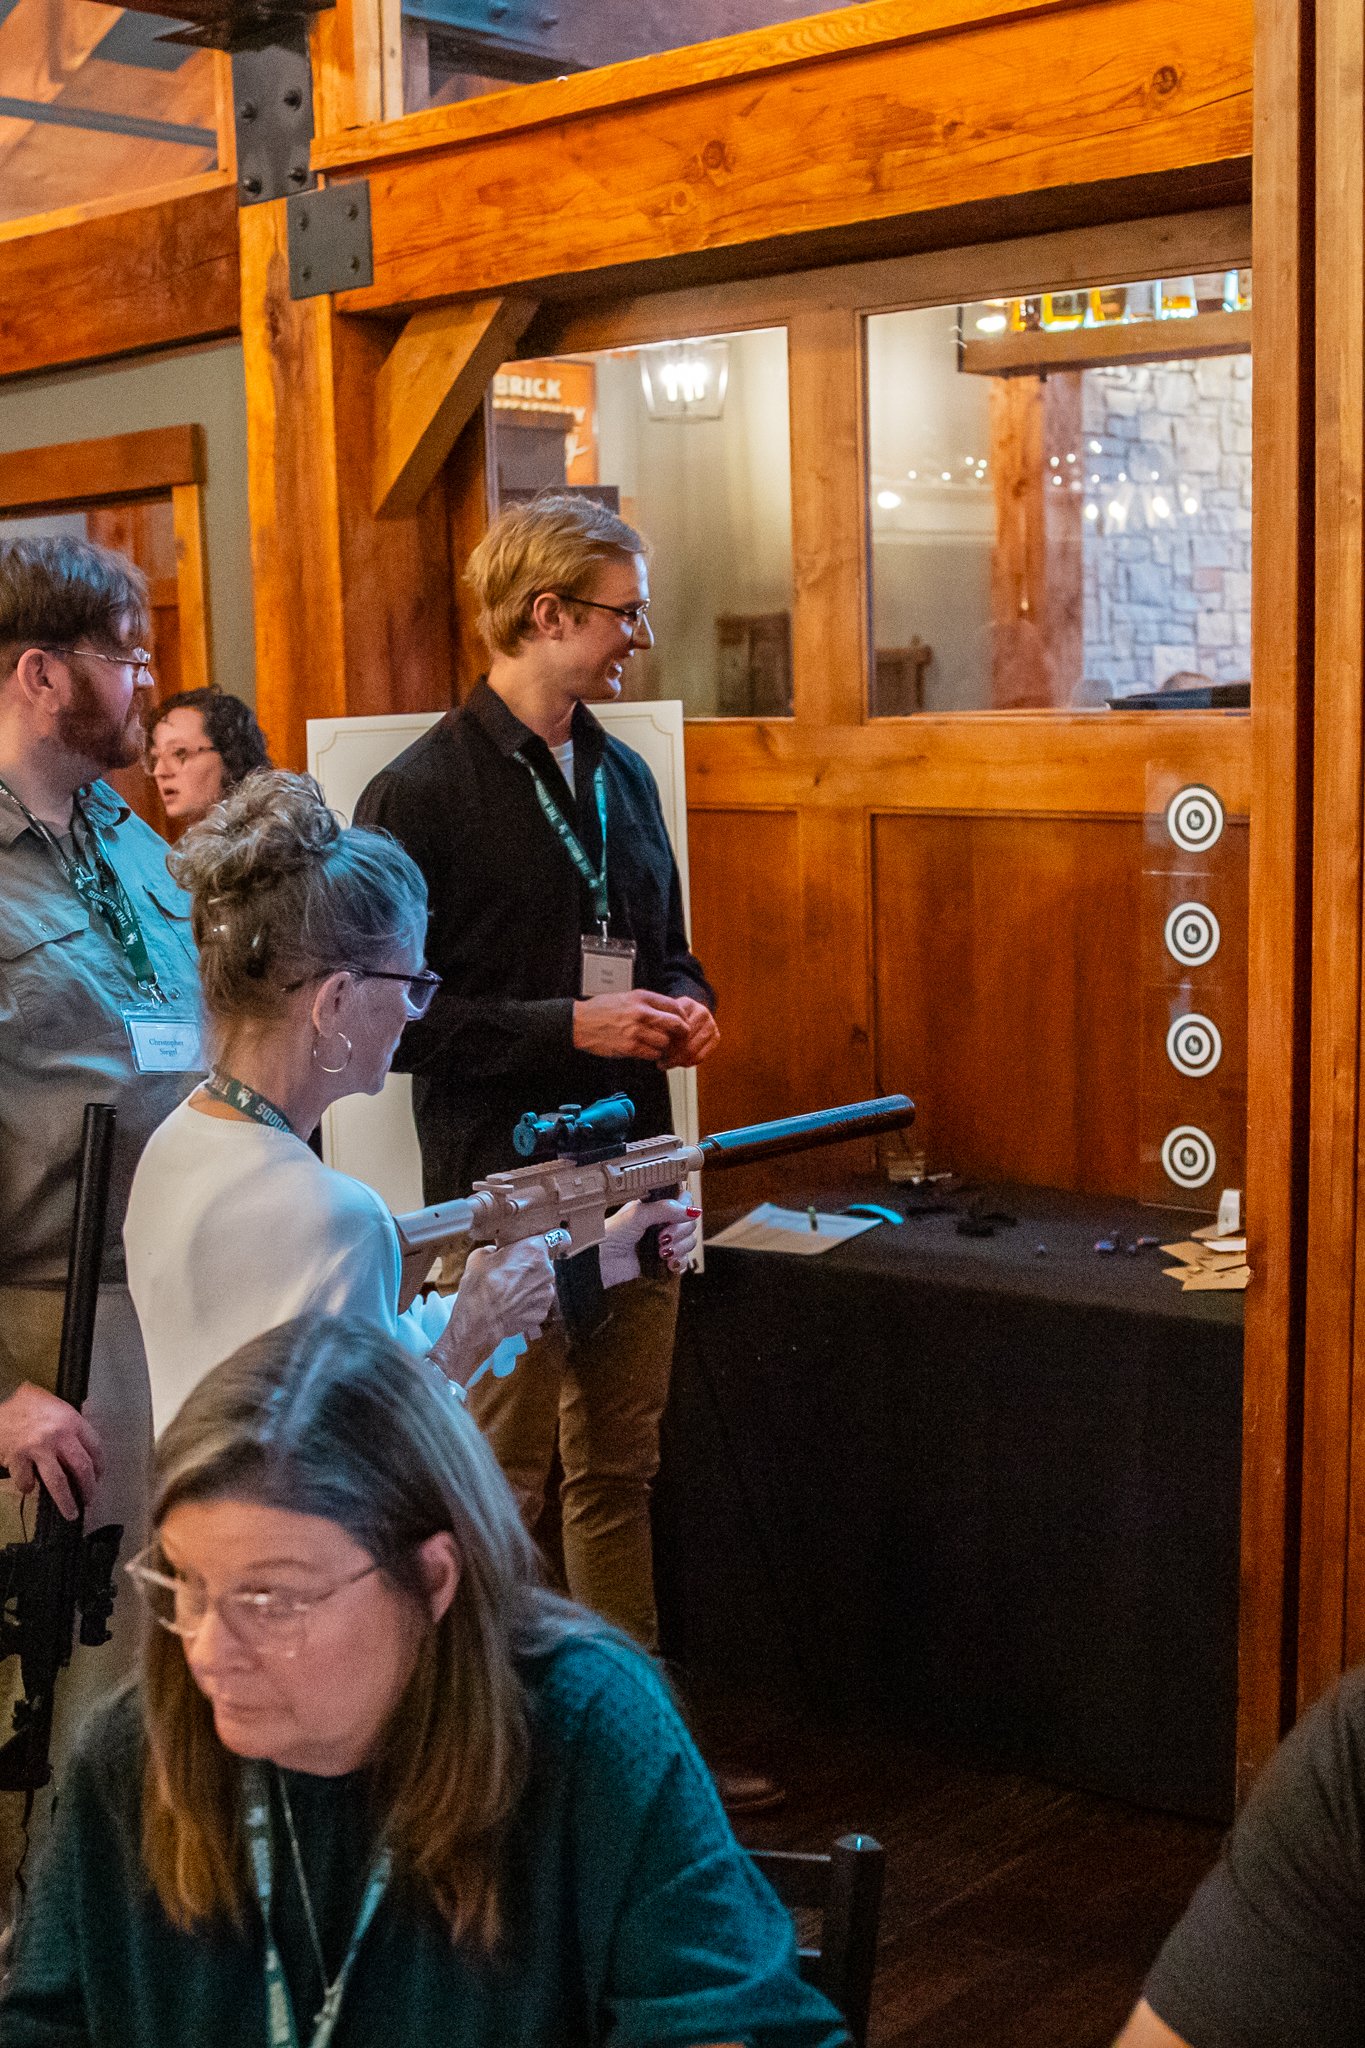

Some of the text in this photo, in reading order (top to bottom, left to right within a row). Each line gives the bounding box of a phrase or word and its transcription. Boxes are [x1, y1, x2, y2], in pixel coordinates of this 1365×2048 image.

[493, 374, 561, 400] BRICK
[87, 890, 129, 928] THE WOODS
